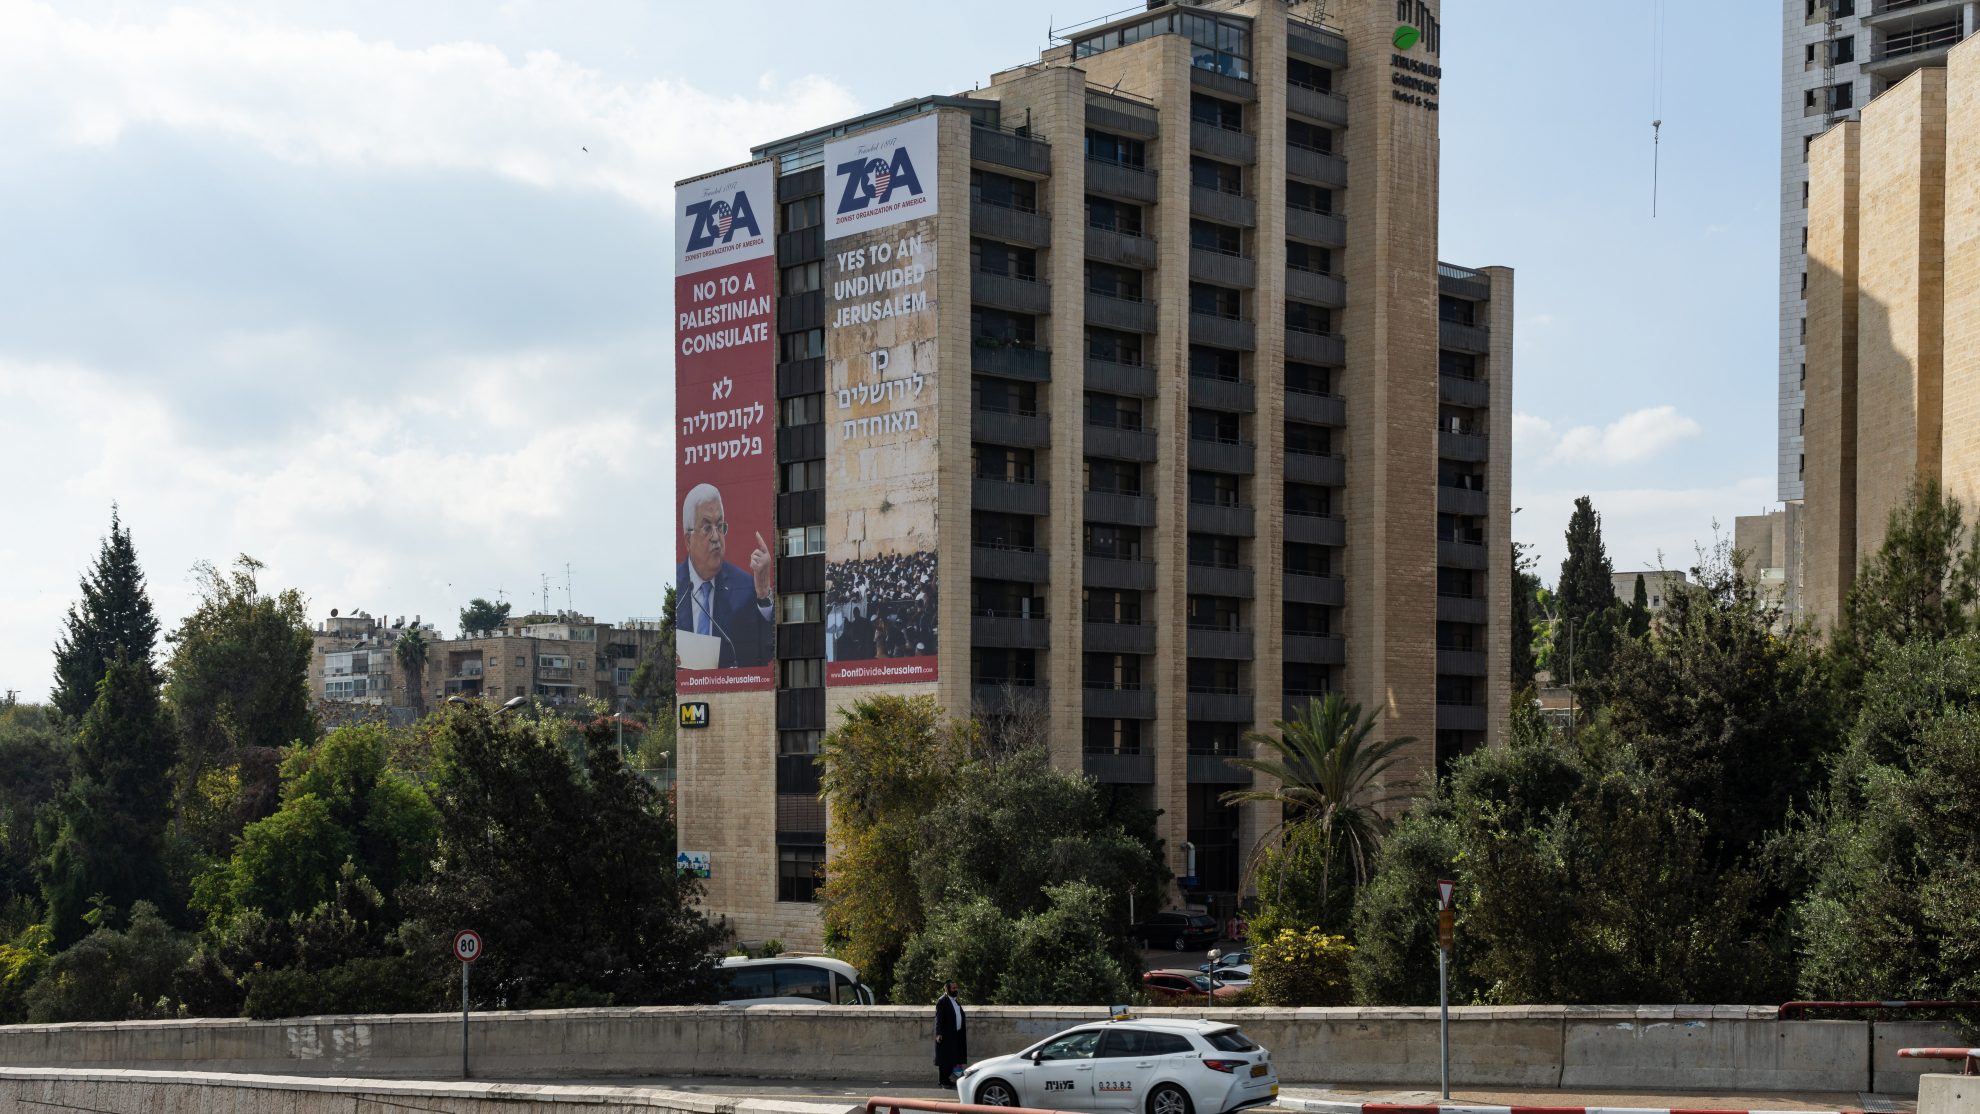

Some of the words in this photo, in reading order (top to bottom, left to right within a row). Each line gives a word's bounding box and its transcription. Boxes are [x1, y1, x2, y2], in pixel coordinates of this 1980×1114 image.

[837, 147, 923, 215] ZOA
[686, 191, 761, 253] ZOA
[836, 214, 855, 224] ZIONIST
[856, 205, 893, 219] ORGANIZATION
[894, 203, 901, 211] OF
[902, 197, 927, 208] AMERICA
[685, 252, 702, 262] ZIONIST
[702, 244, 735, 258] ORGANIZATION
[736, 242, 742, 250] OF
[742, 238, 764, 248] AMERICA
[837, 249, 865, 272] YES
[869, 243, 892, 265] TO
[896, 235, 921, 259] AN
[693, 281, 716, 302] NO
[720, 275, 740, 296] TO
[744, 273, 756, 291] A
[834, 264, 926, 300] UNDIVIDED
[680, 295, 771, 331] PALESTINIAN
[832, 291, 927, 328] JERUSALEM
[682, 322, 768, 355] CONSULATE
[870, 351, 889, 375] כן
[712, 376, 733, 400] לא
[838, 372, 924, 409] לירושלים
[683, 401, 764, 435] לקונסוליה
[843, 410, 918, 440] מאוחדת
[684, 434, 762, 465] פלסטינית
[681, 704, 705, 721] MM
[460, 939, 474, 952] 80
